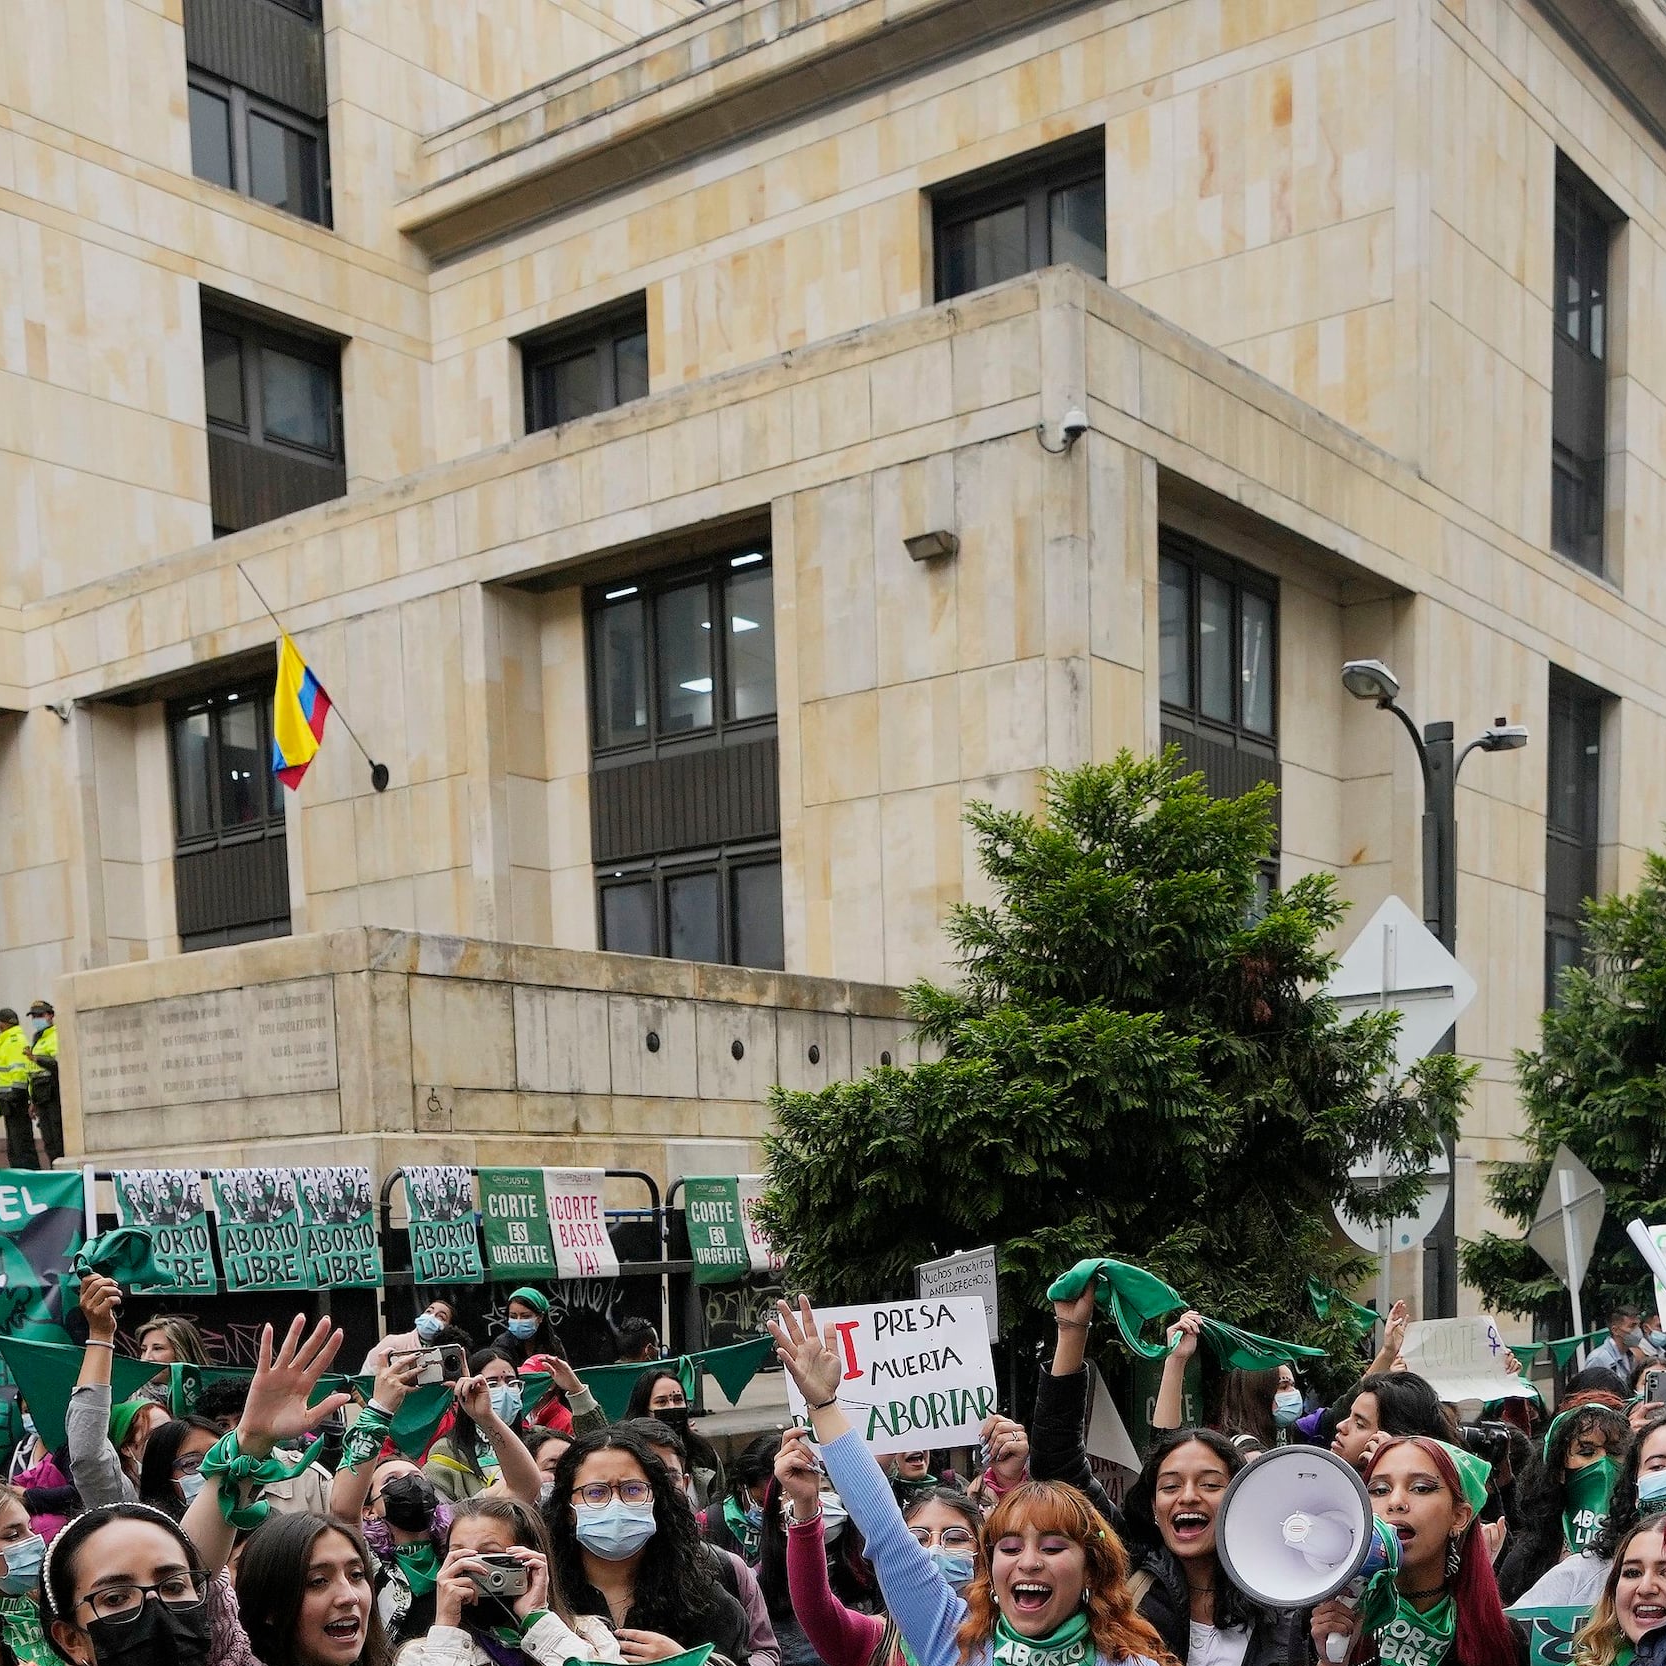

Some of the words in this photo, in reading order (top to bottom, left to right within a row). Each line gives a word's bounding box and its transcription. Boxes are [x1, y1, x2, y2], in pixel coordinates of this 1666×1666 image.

[0, 1183, 47, 1221] EL
[488, 1193, 538, 1218] CORTE
[549, 1196, 598, 1221] ¡CORTE
[691, 1201, 733, 1223] CORTE
[153, 1224, 210, 1256] ORTO
[225, 1222, 300, 1258] ABORTO
[308, 1222, 375, 1258] ABORTO
[415, 1221, 475, 1252] ABORTO
[512, 1225, 525, 1242] ES
[559, 1223, 604, 1247] BASTA
[712, 1229, 724, 1244] ES
[232, 1253, 301, 1287] LIBRE
[314, 1253, 376, 1287] LIBRE
[420, 1250, 477, 1280] LIBRE
[492, 1246, 549, 1264] URGENTE
[575, 1252, 601, 1275] YA!
[696, 1248, 744, 1264] URGENTE
[874, 1304, 956, 1341] PRESA
[871, 1346, 964, 1386] MUERTA
[866, 1384, 997, 1441] ABORTAR
[994, 1640, 1085, 1666] ABORTO
